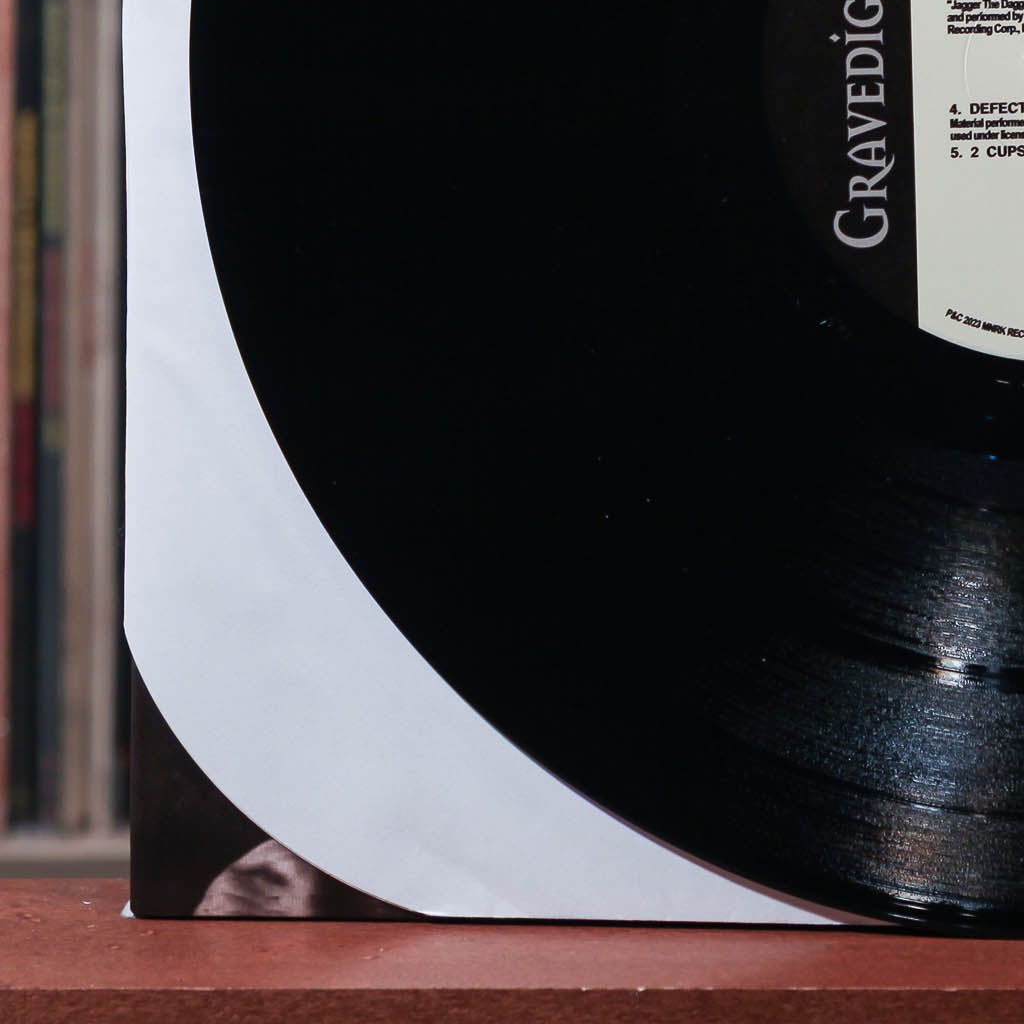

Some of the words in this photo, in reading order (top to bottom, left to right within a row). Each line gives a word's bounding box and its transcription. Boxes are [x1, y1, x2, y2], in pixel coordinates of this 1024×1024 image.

[982, 0, 1000, 9] The
[947, 12, 964, 22] and
[966, 11, 1011, 24] performed
[1012, 10, 1023, 22] by
[947, 24, 993, 36] Recording
[949, 103, 961, 115] 4.
[950, 118, 984, 129] Material
[950, 130, 972, 141] used
[973, 130, 999, 140] under
[950, 147, 962, 158] 5.
[970, 147, 979, 158] 2
[945, 309, 963, 322] P&C
[963, 315, 982, 329] 2023
